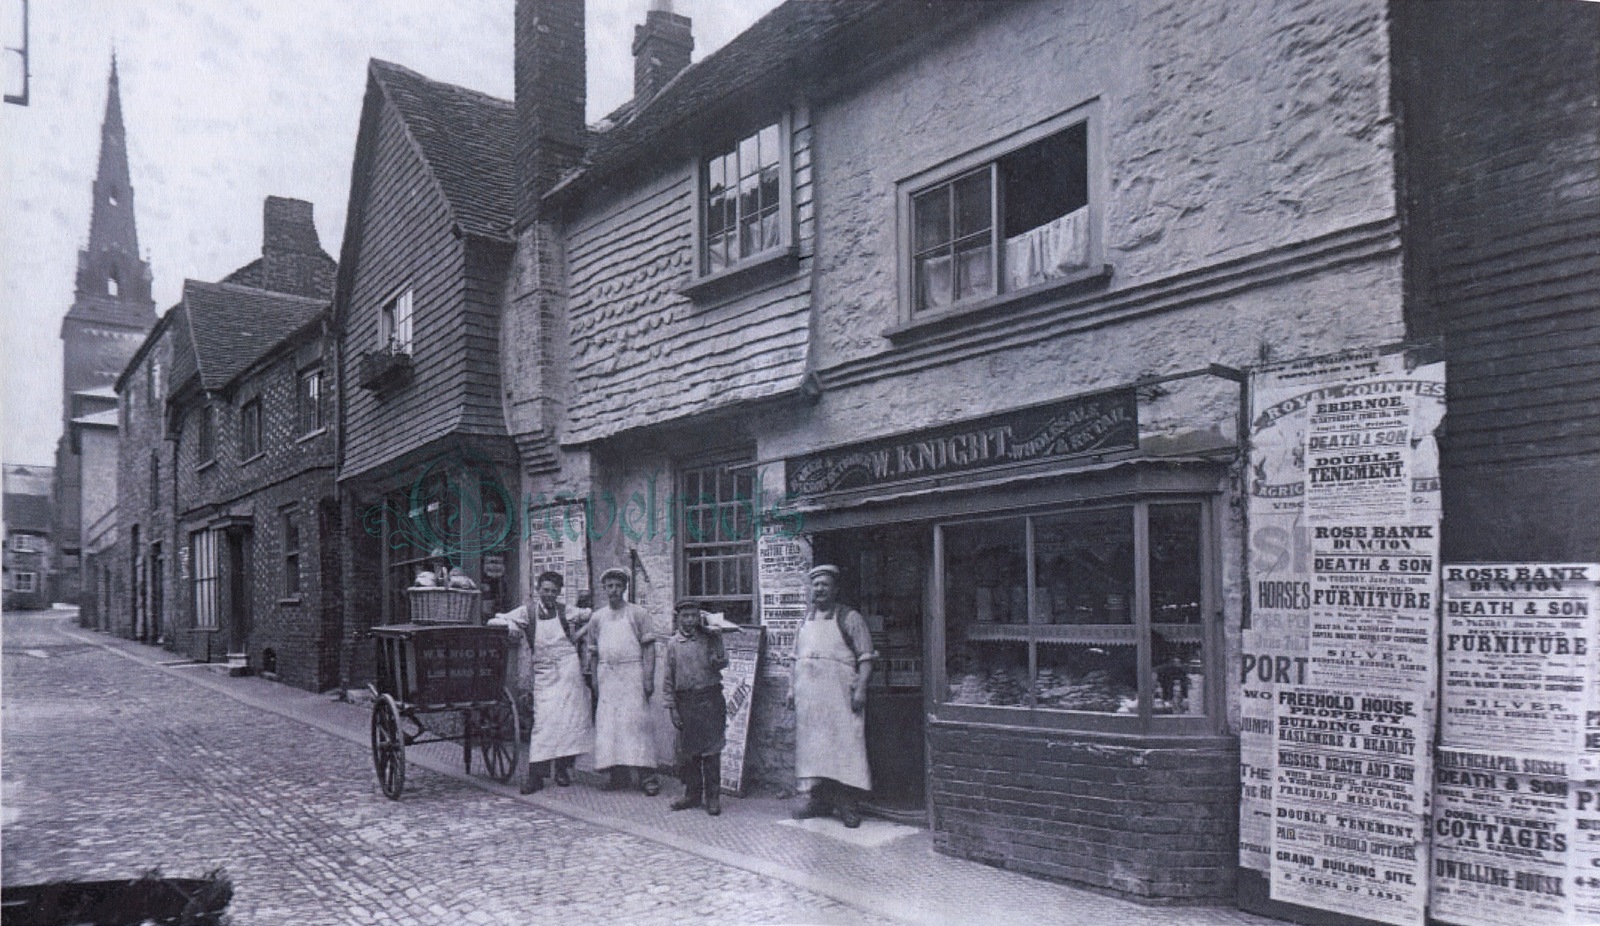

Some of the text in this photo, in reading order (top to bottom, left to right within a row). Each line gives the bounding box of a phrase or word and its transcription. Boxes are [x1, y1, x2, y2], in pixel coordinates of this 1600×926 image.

[1310, 432, 1360, 449] DEATH
[1375, 429, 1408, 443] SON
[898, 426, 1012, 474] KNIGHT
[1315, 452, 1400, 466] DOUBLE
[1315, 525, 1433, 539] ROSE BANK
[1333, 540, 1411, 550] DUNCTON
[1314, 558, 1432, 572] DEATH & SON
[1447, 567, 1590, 582] ROSE BANK
[1259, 581, 1310, 609] HORSES
[1470, 581, 1563, 592] DUNCTON
[1313, 590, 1430, 609] FURNITURE
[1449, 601, 1589, 616] DEATH & SON
[1447, 634, 1587, 655] FURNITURE
[1240, 654, 1308, 685] PORT
[1279, 692, 1354, 710] FREEHOLD
[1279, 716, 1361, 733] BUILDING
[1279, 729, 1344, 746] HASLEMERE
[1350, 737, 1357, 748] &
[1363, 738, 1416, 755] HEADLEY
[1240, 764, 1271, 780] THE
[1325, 758, 1363, 774] DEATH
[1367, 762, 1390, 777] AND
[1393, 765, 1415, 781] SON
[1289, 778, 1343, 790] WEDNESDAY
[1349, 785, 1374, 796] JULY
[1437, 769, 1569, 796] DEATH & SON
[1280, 785, 1338, 801] FREEHOLD
[1276, 807, 1327, 824] DOUBLE
[1445, 809, 1557, 831] DOUBLE TENEMENT
[1276, 826, 1296, 840] PAIR
[1436, 818, 1567, 852] COTTAGES
[1323, 834, 1367, 852] FREEHOLD
[1276, 851, 1315, 866] GRAND
[1322, 858, 1376, 878] BUILDING
[1300, 876, 1339, 889] ACRES
[1346, 884, 1360, 893] OF
